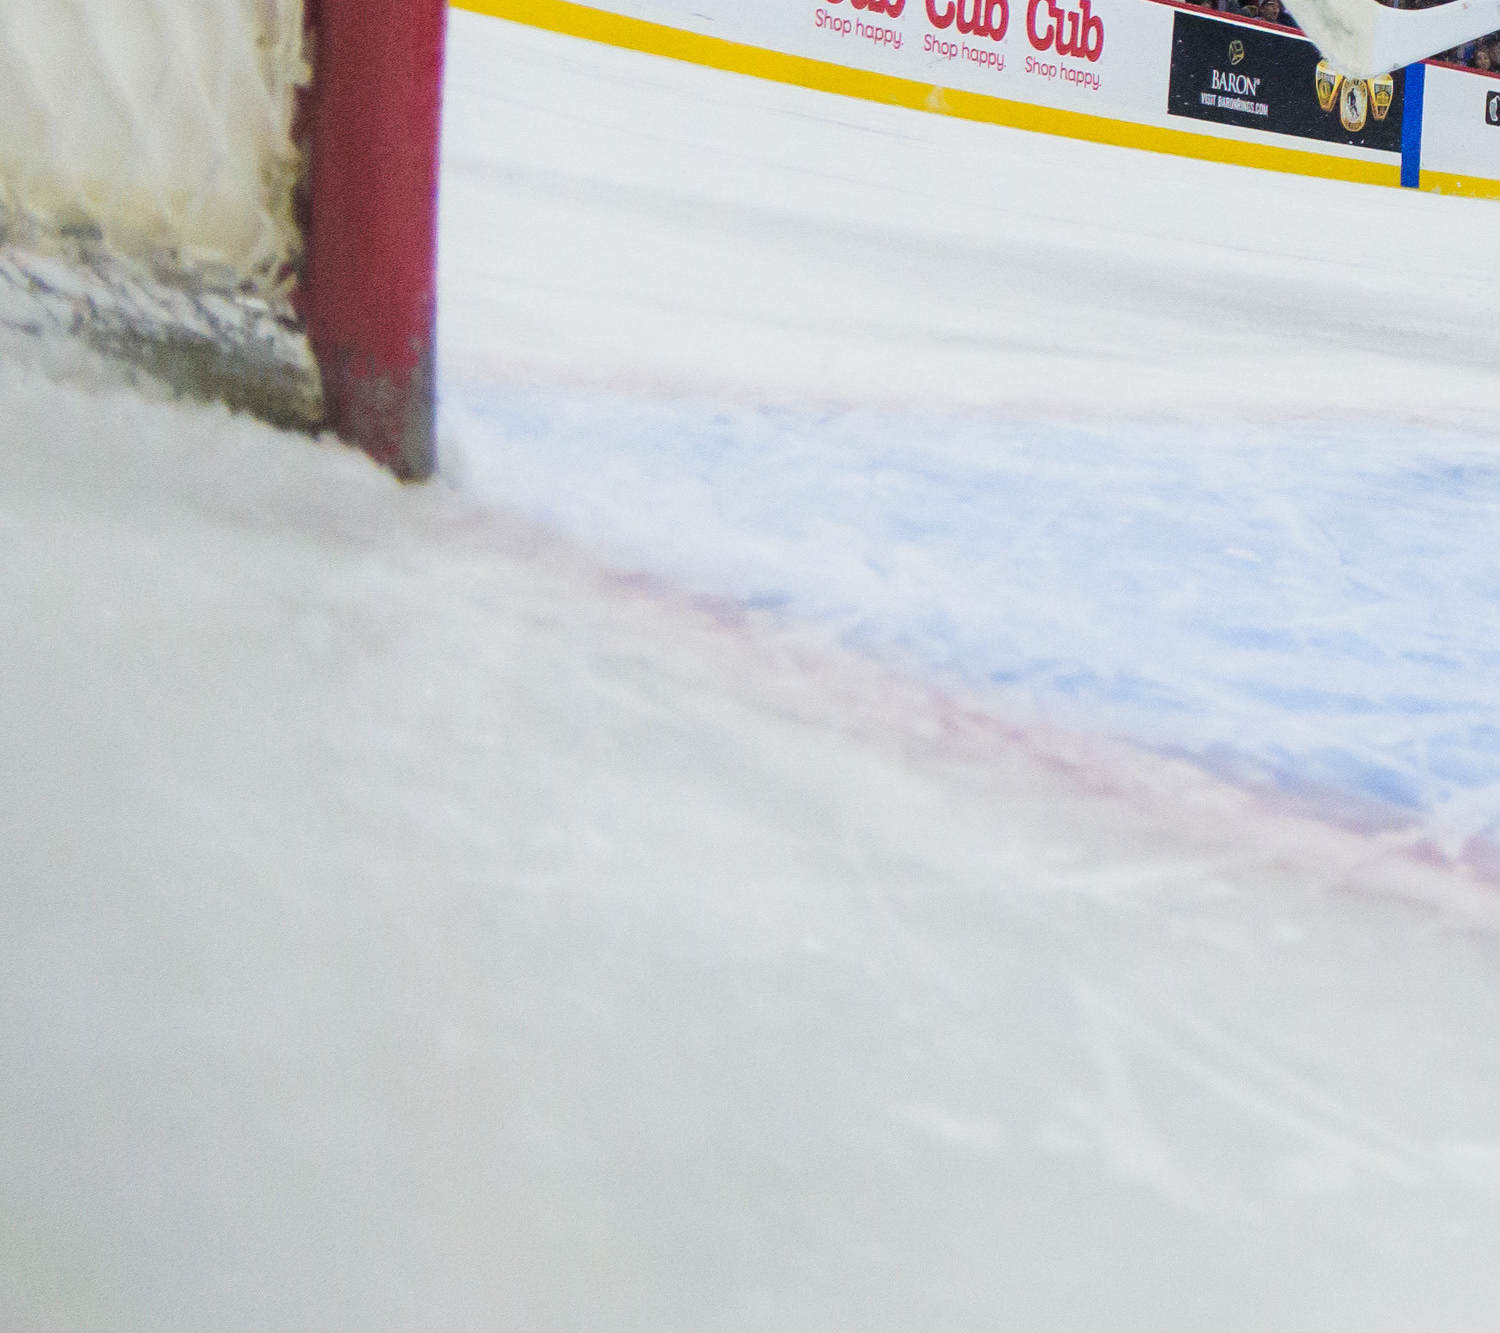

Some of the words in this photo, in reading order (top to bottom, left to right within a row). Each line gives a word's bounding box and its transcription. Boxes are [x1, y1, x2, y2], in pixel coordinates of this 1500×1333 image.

[815, 8, 851, 38] Shop
[924, 33, 958, 61] Shop
[1025, 55, 1057, 81] Shop
